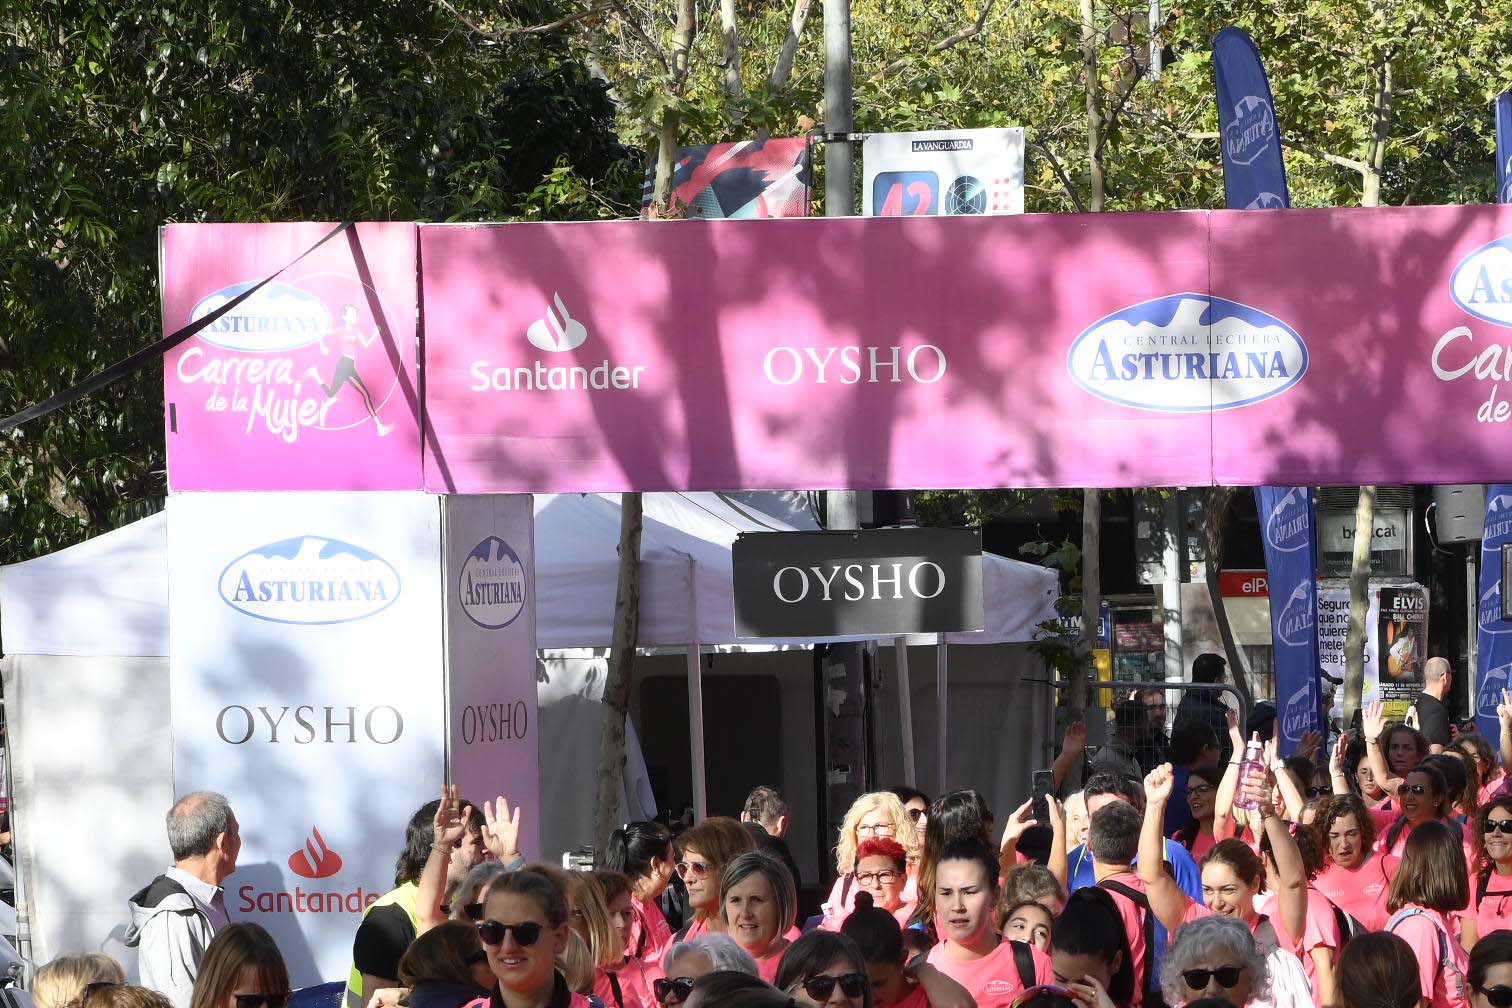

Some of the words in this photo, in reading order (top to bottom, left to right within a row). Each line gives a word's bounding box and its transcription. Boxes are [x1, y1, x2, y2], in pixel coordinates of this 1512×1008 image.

[1123, 335, 1199, 347] CENTRAL
[1204, 333, 1282, 345] LECHERA
[176, 347, 293, 384] Carrera
[470, 359, 645, 393] Santander
[763, 344, 948, 387] OYSHO
[1087, 339, 1290, 382] ASTURIANA
[206, 385, 229, 412] de
[232, 388, 249, 412] la
[246, 380, 338, 442] Mujer
[1476, 384, 1512, 423] de
[232, 568, 388, 602] ASTURIANA
[464, 574, 523, 607] ASTURIANA
[772, 562, 946, 604] OYSHO
[1318, 614, 1335, 626] que
[1393, 596, 1424, 610] ELVIS
[1319, 626, 1349, 640] quiere
[1320, 653, 1339, 664] este
[215, 704, 404, 745] OYSHO
[461, 701, 529, 745] OYSHO
[238, 885, 382, 913] Santande
